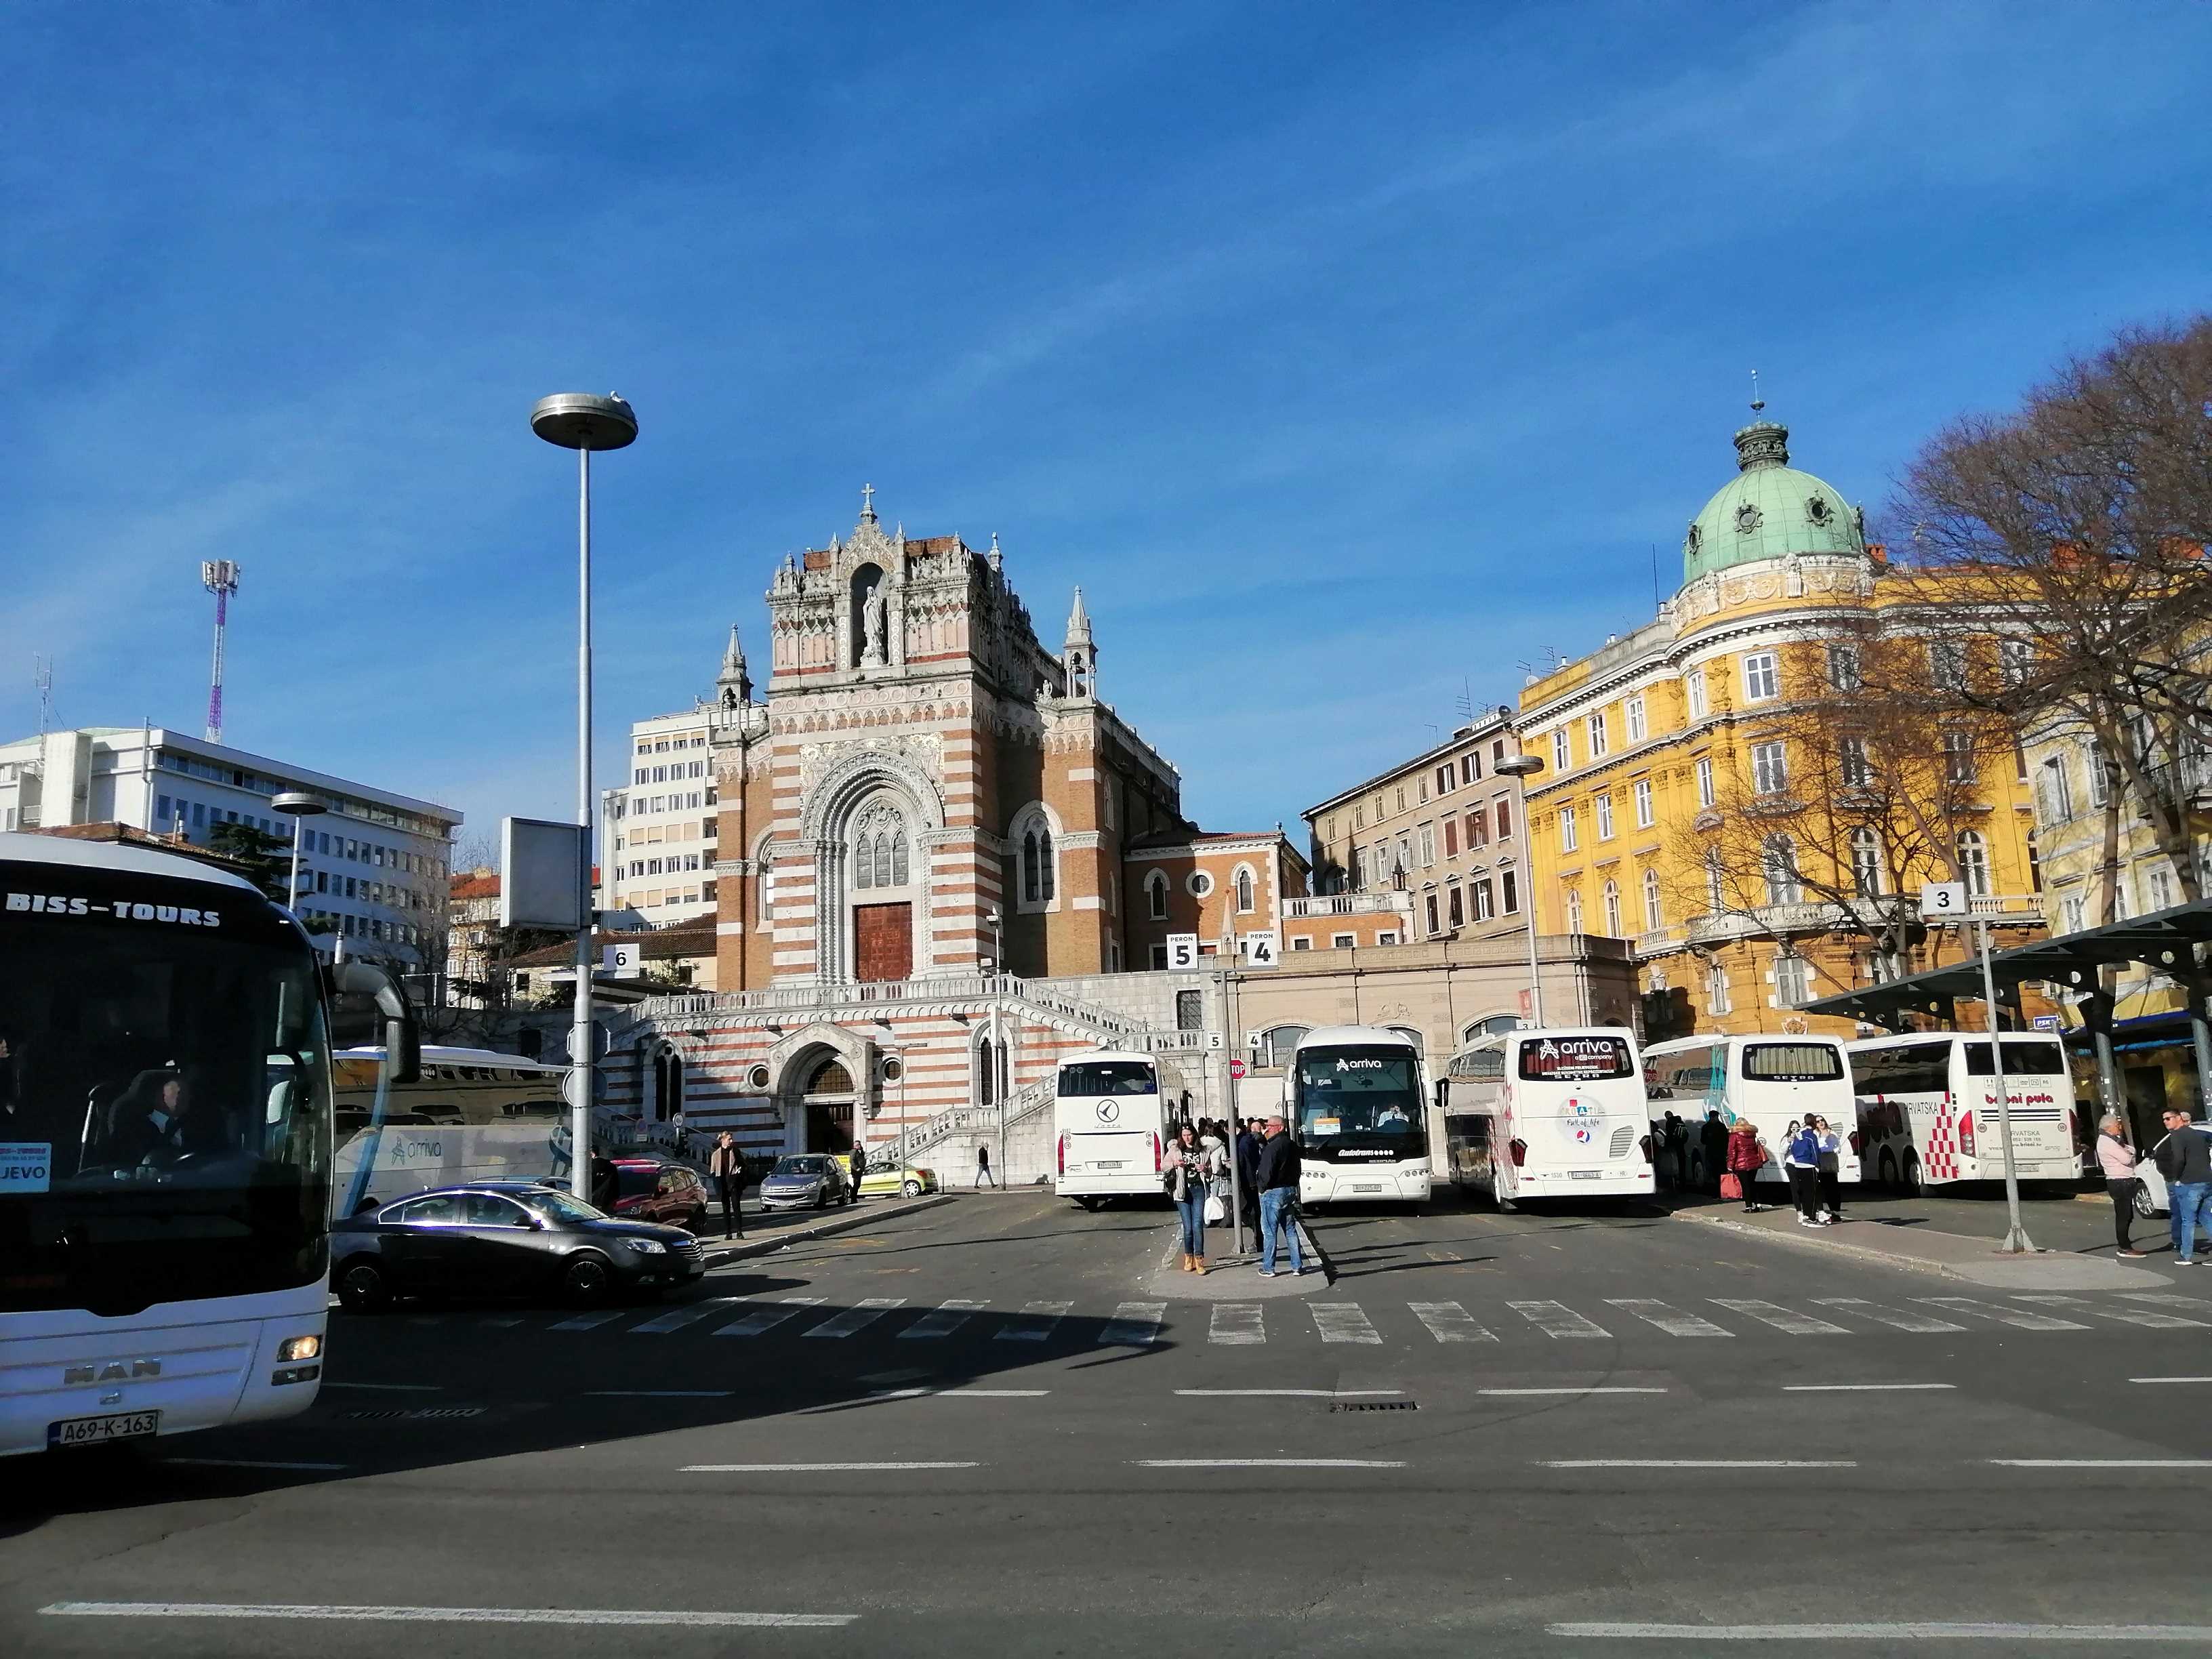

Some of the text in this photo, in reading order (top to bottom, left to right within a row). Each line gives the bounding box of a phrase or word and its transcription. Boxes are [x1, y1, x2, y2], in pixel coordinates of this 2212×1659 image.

[1937, 890, 1950, 908] 3
[5, 893, 220, 927] BISS-TOURS
[615, 951, 627, 966] 6
[1175, 945, 1191, 966] 5
[1254, 942, 1271, 962] 4
[1212, 1036, 1219, 1047] 5
[1250, 1036, 1258, 1046] 4
[1560, 1038, 1612, 1054] arriva
[1231, 1065, 1245, 1074] TOP
[1349, 1058, 1382, 1068] arriva
[2026, 1092, 2054, 1106] pula
[1903, 1101, 1938, 1115] HRVATSKA
[407, 1138, 441, 1158] arriva
[1338, 1149, 1374, 1157] Autotrans
[64, 1357, 161, 1385] MAN
[64, 1414, 155, 1442] A69-K-163
